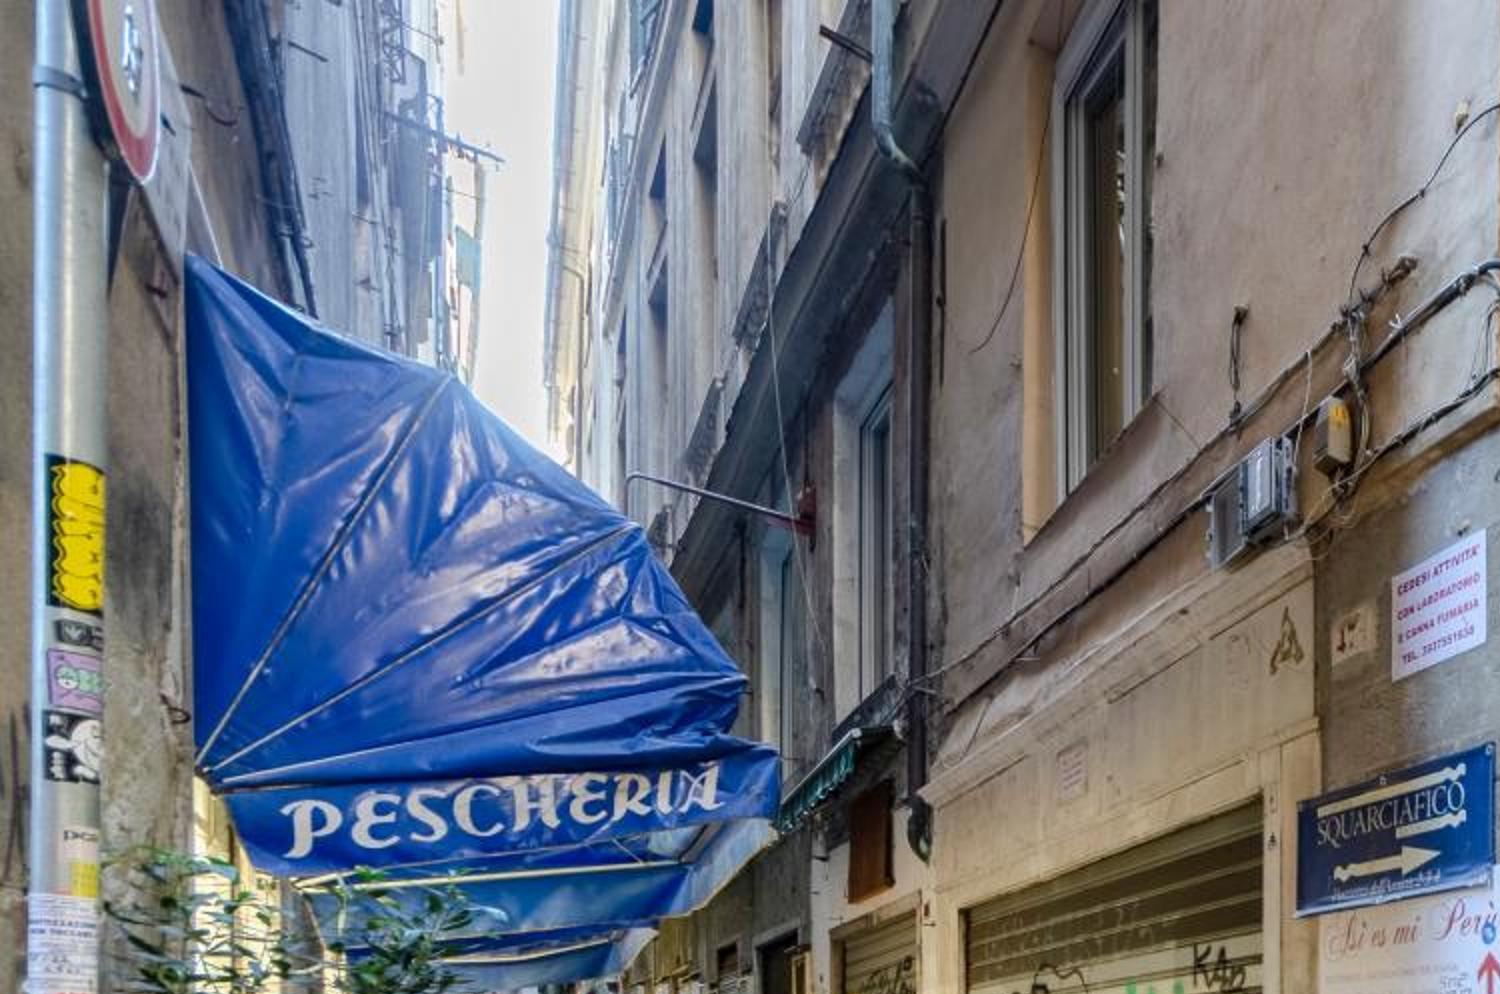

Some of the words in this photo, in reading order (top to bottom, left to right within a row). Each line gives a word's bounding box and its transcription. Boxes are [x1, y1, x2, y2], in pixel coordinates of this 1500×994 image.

[1398, 573, 1431, 597] CEDESI
[1397, 606, 1415, 621] CON
[280, 760, 726, 860] PESCHERIA
[1317, 781, 1466, 848] SQUARCIAFICO
[1393, 916, 1421, 944] mi
